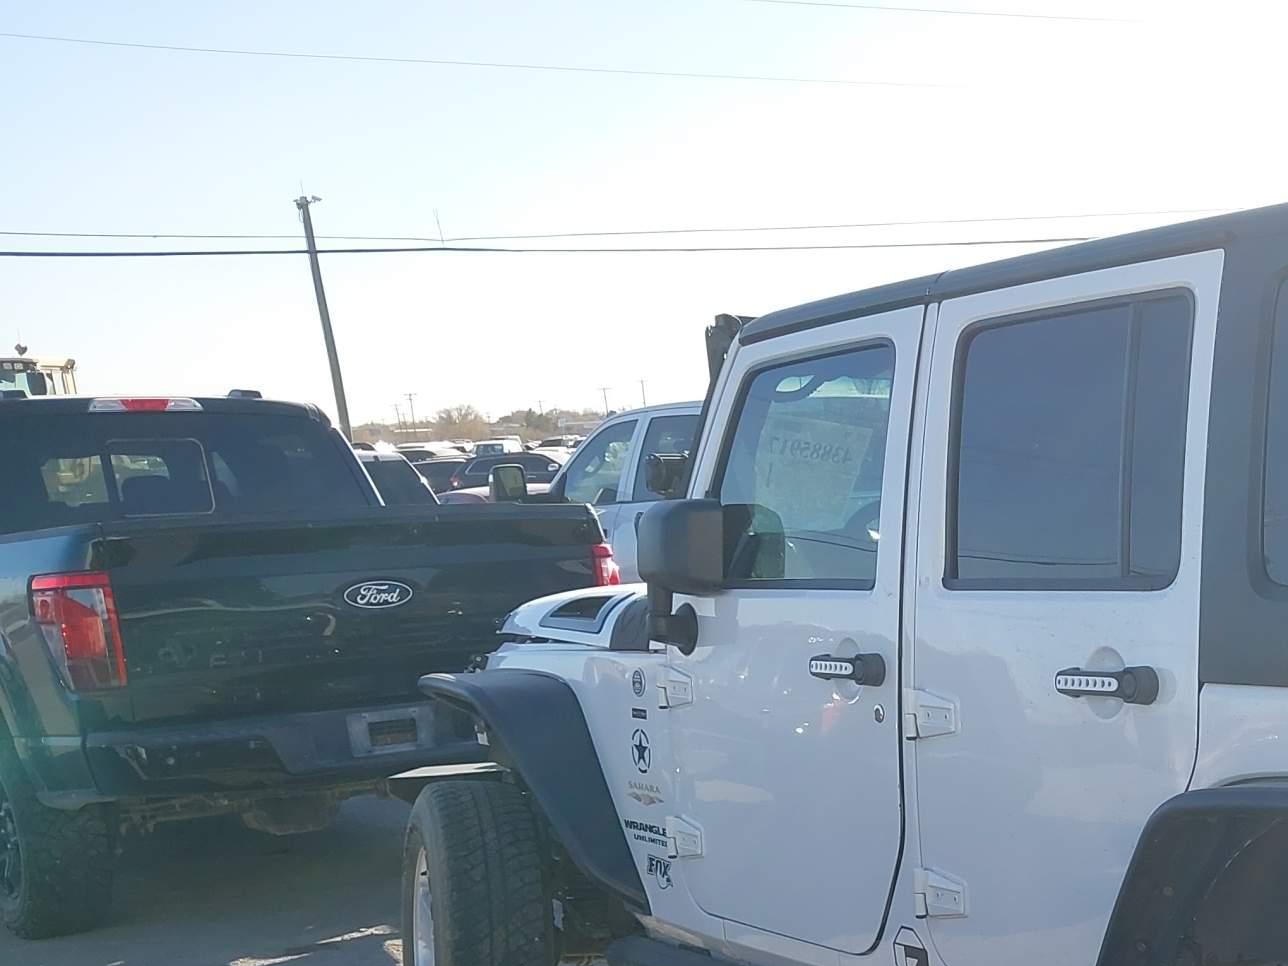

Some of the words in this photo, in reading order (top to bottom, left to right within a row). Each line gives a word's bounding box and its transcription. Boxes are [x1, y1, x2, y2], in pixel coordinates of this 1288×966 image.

[357, 585, 400, 604] Ford
[628, 780, 662, 794] SAHARA
[624, 819, 667, 837] WRANGLE
[647, 854, 672, 878] FOX
